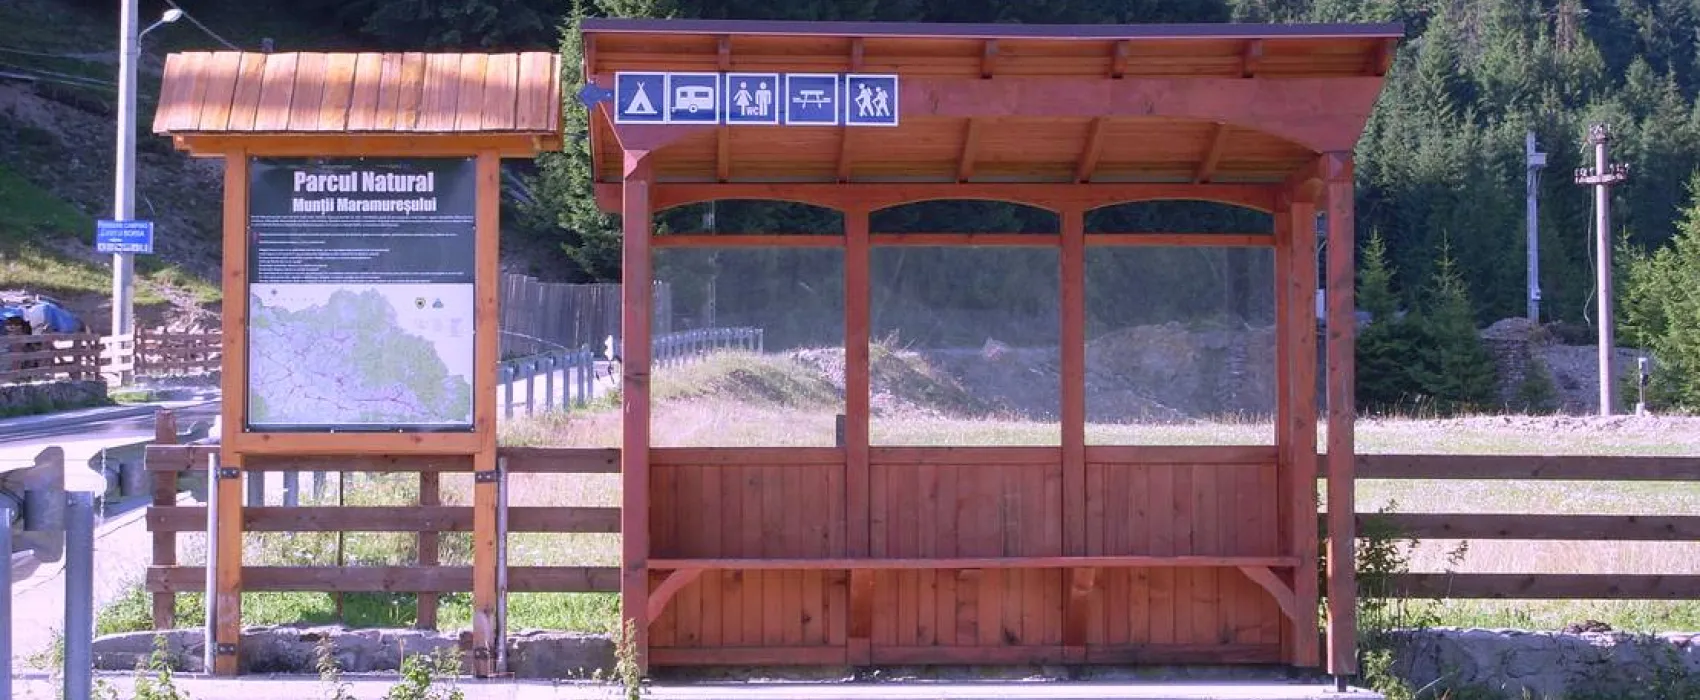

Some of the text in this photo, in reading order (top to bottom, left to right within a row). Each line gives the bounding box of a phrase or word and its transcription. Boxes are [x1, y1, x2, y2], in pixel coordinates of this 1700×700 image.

[746, 106, 759, 116] WC
[293, 171, 434, 192] Parcul Natural
